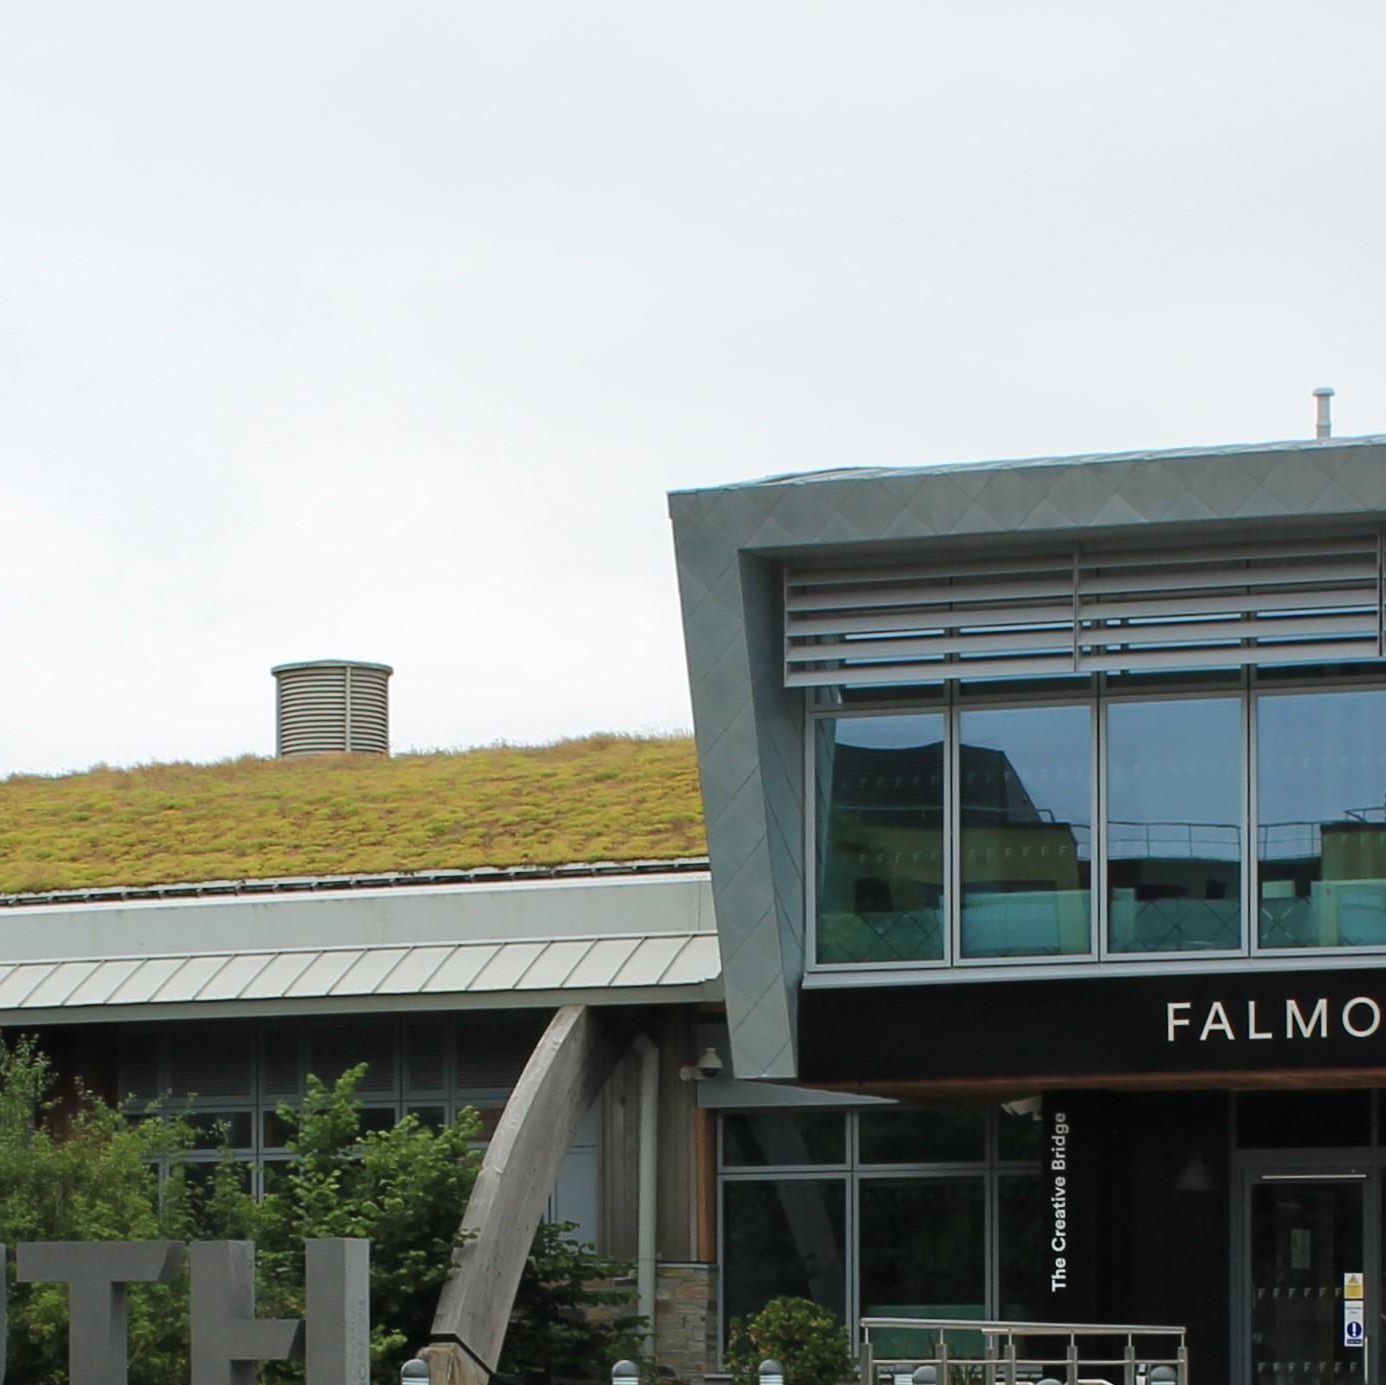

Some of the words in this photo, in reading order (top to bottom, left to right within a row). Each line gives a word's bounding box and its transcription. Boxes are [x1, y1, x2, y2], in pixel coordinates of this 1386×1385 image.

[1051, 1112, 1069, 1171] Bridge
[1051, 1176, 1067, 1252] Creative
[1051, 1257, 1067, 1292] The
